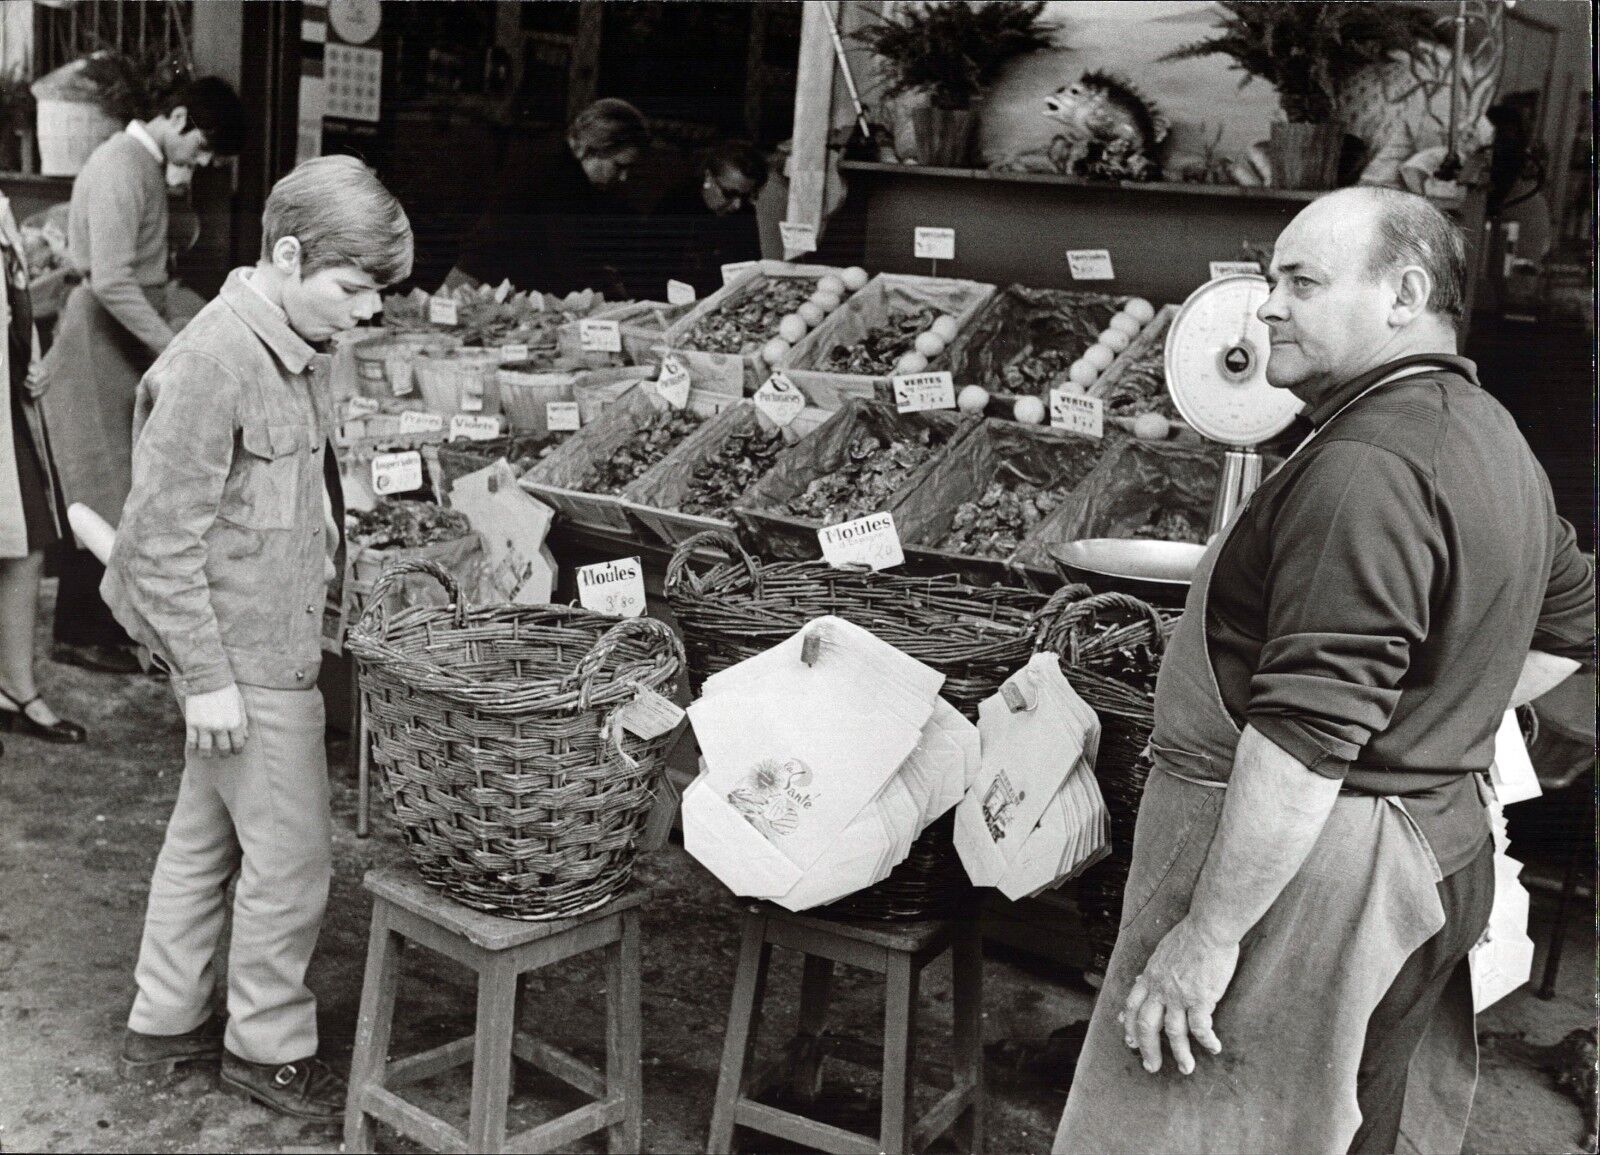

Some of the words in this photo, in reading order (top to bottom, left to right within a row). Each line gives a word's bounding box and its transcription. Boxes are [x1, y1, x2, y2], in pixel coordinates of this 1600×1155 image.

[904, 376, 942, 386] VERTES
[1060, 396, 1094, 410] VERTES
[824, 517, 892, 544] Moules
[582, 565, 636, 587] Moules
